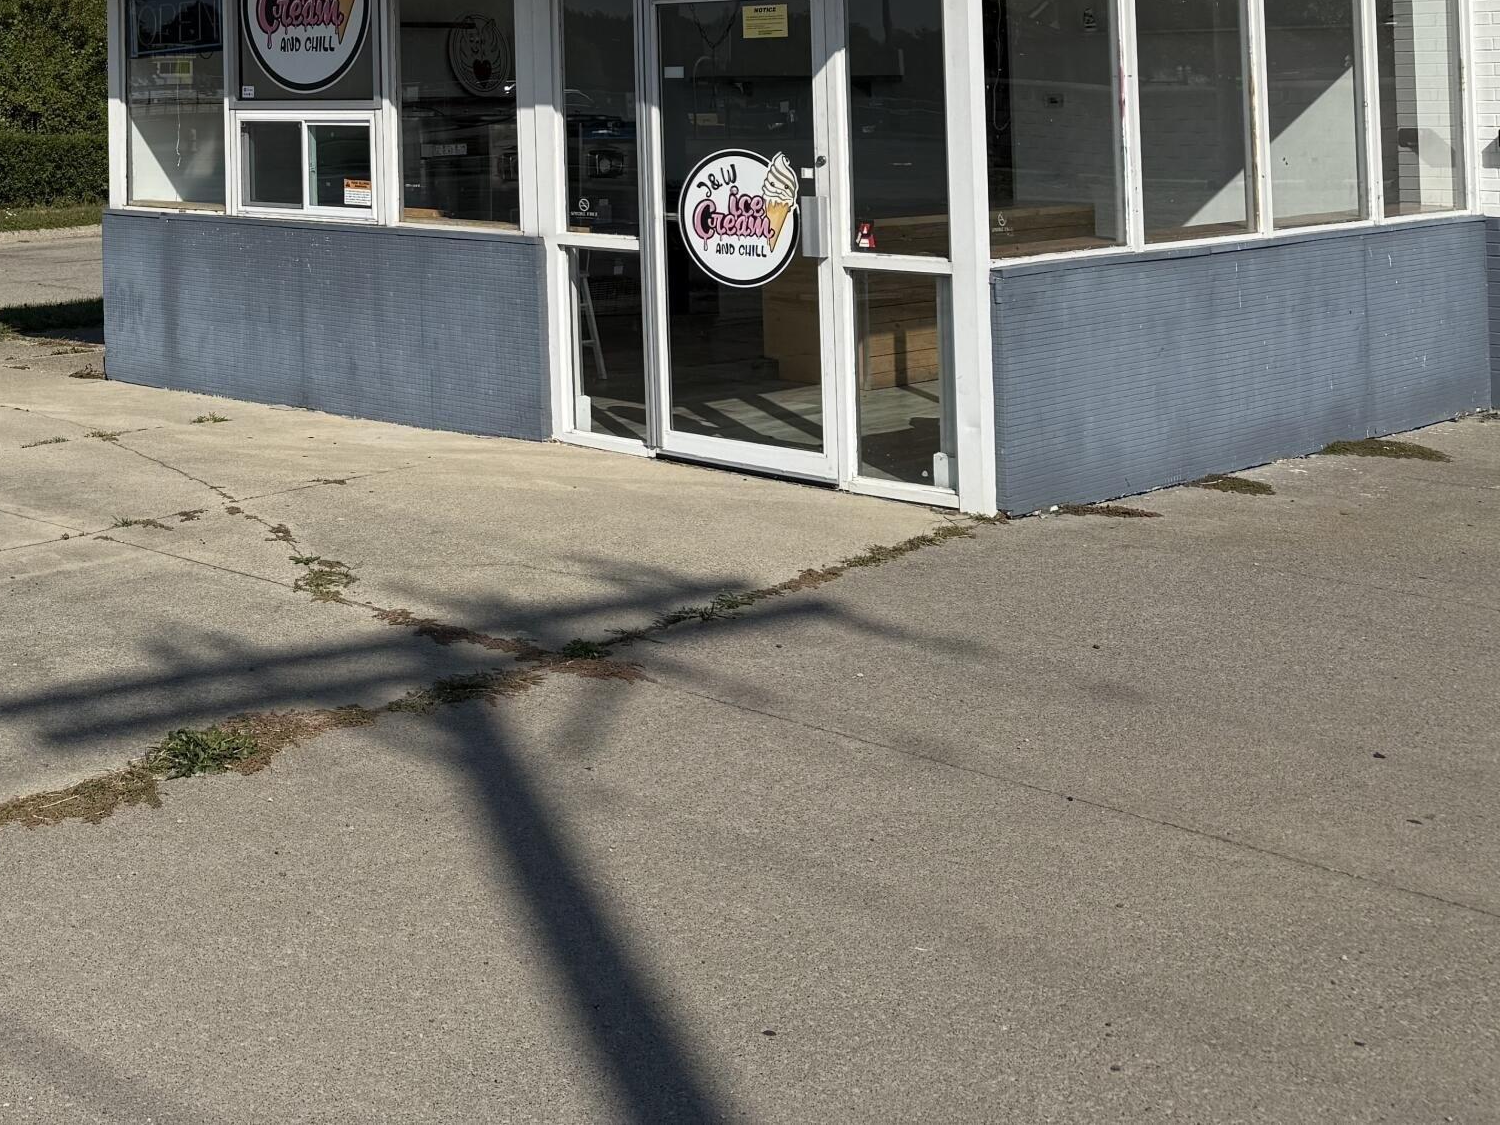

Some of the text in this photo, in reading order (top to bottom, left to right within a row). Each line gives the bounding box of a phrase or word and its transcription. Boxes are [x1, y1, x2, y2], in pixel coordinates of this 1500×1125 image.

[754, 6, 777, 14] NOTICE
[280, 36, 335, 52] AND CHILL
[697, 164, 737, 197] J&W
[728, 185, 765, 217] ice
[692, 198, 775, 248] Cream
[715, 243, 767, 257] AND CHILL
